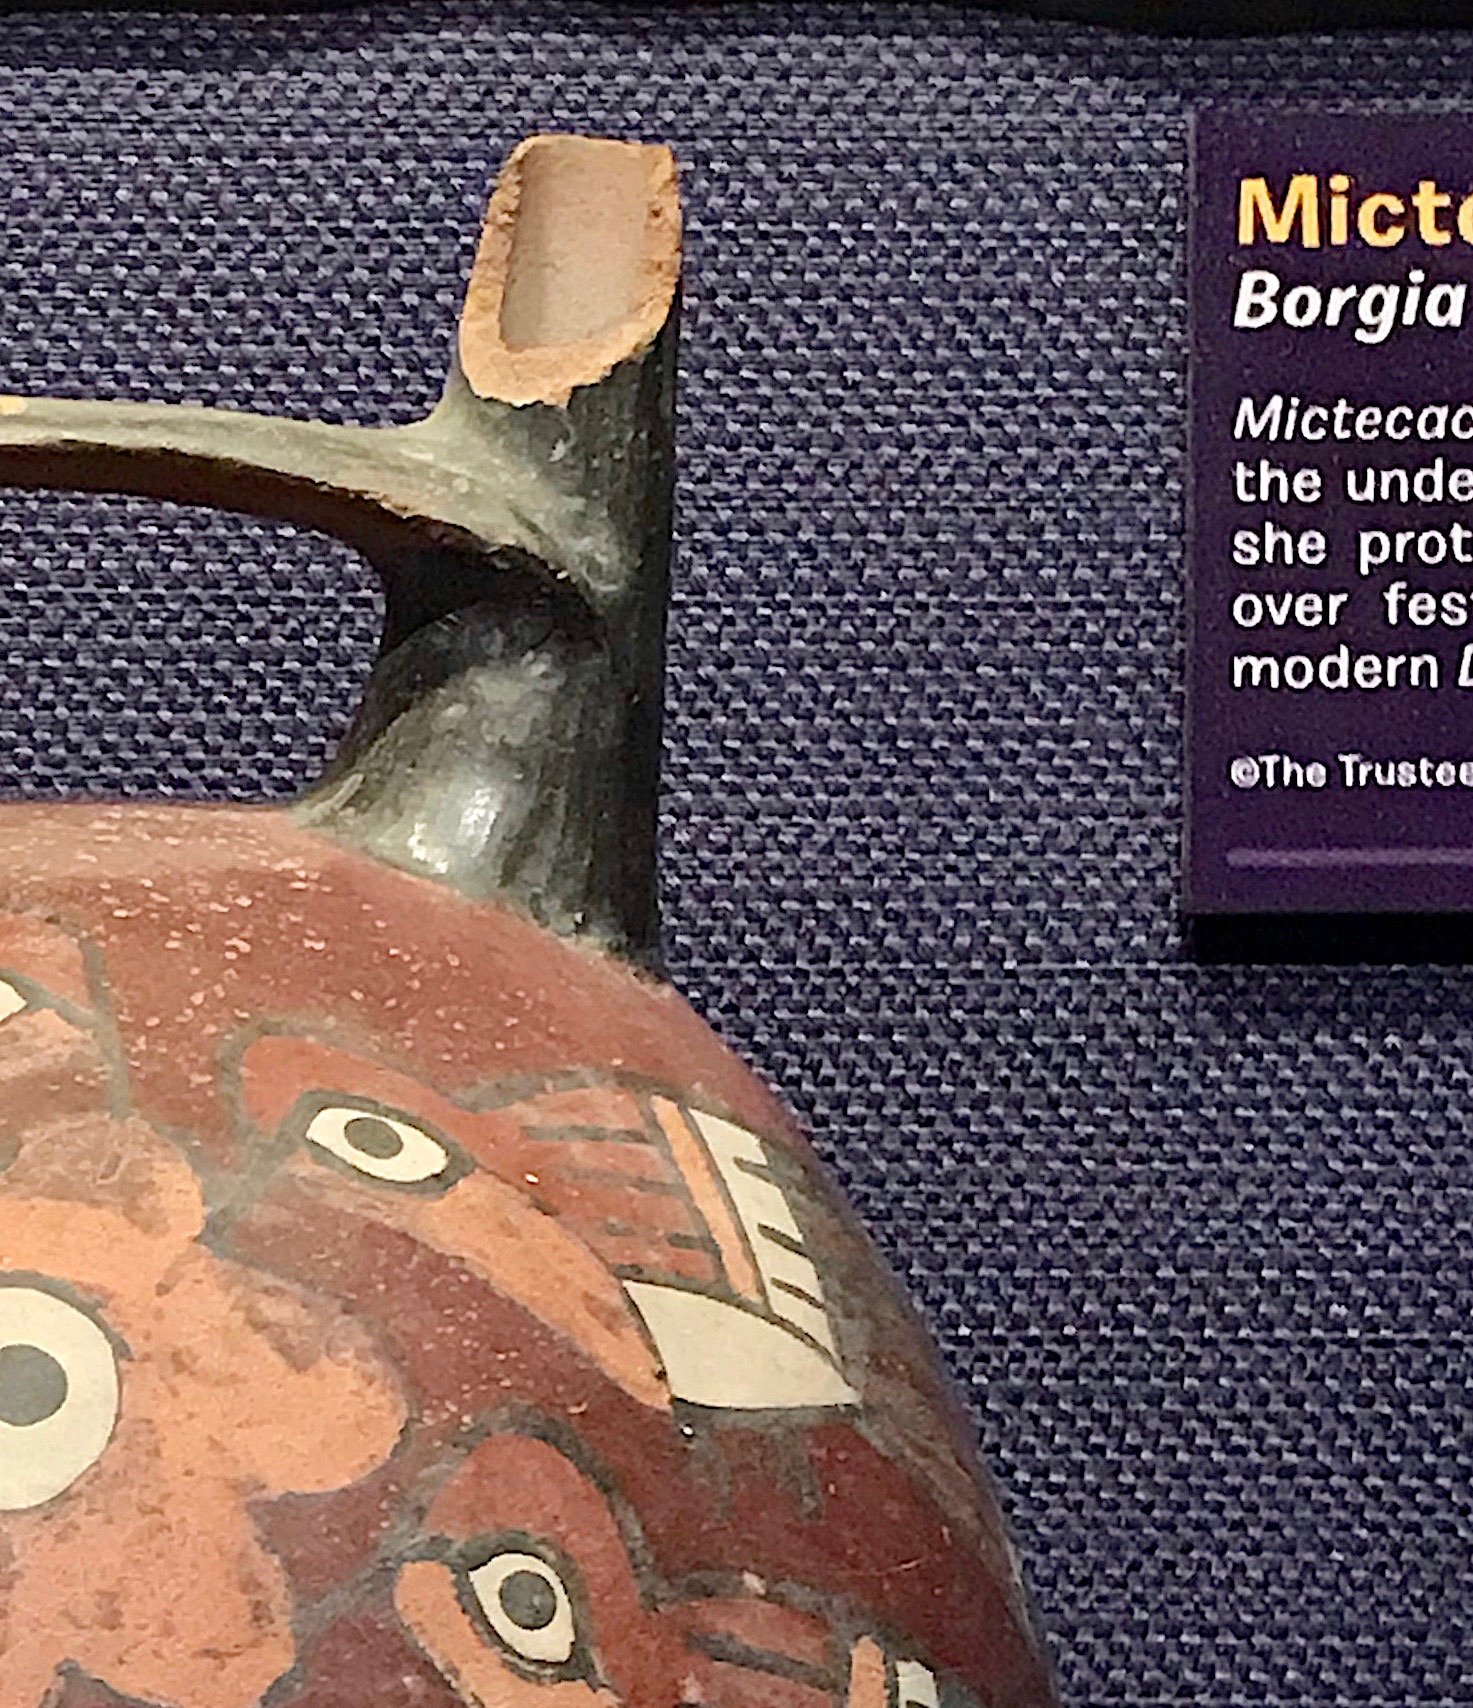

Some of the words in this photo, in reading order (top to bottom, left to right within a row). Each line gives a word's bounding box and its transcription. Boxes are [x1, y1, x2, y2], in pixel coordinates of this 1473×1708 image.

[1233, 268, 1467, 345] Borgia
[1234, 459, 1322, 504] the
[1347, 456, 1473, 504] unde
[1232, 521, 1327, 566] she
[1359, 522, 1473, 576] prot
[1232, 591, 1349, 628] over
[1382, 581, 1473, 628] fes
[1233, 643, 1439, 690] modern
